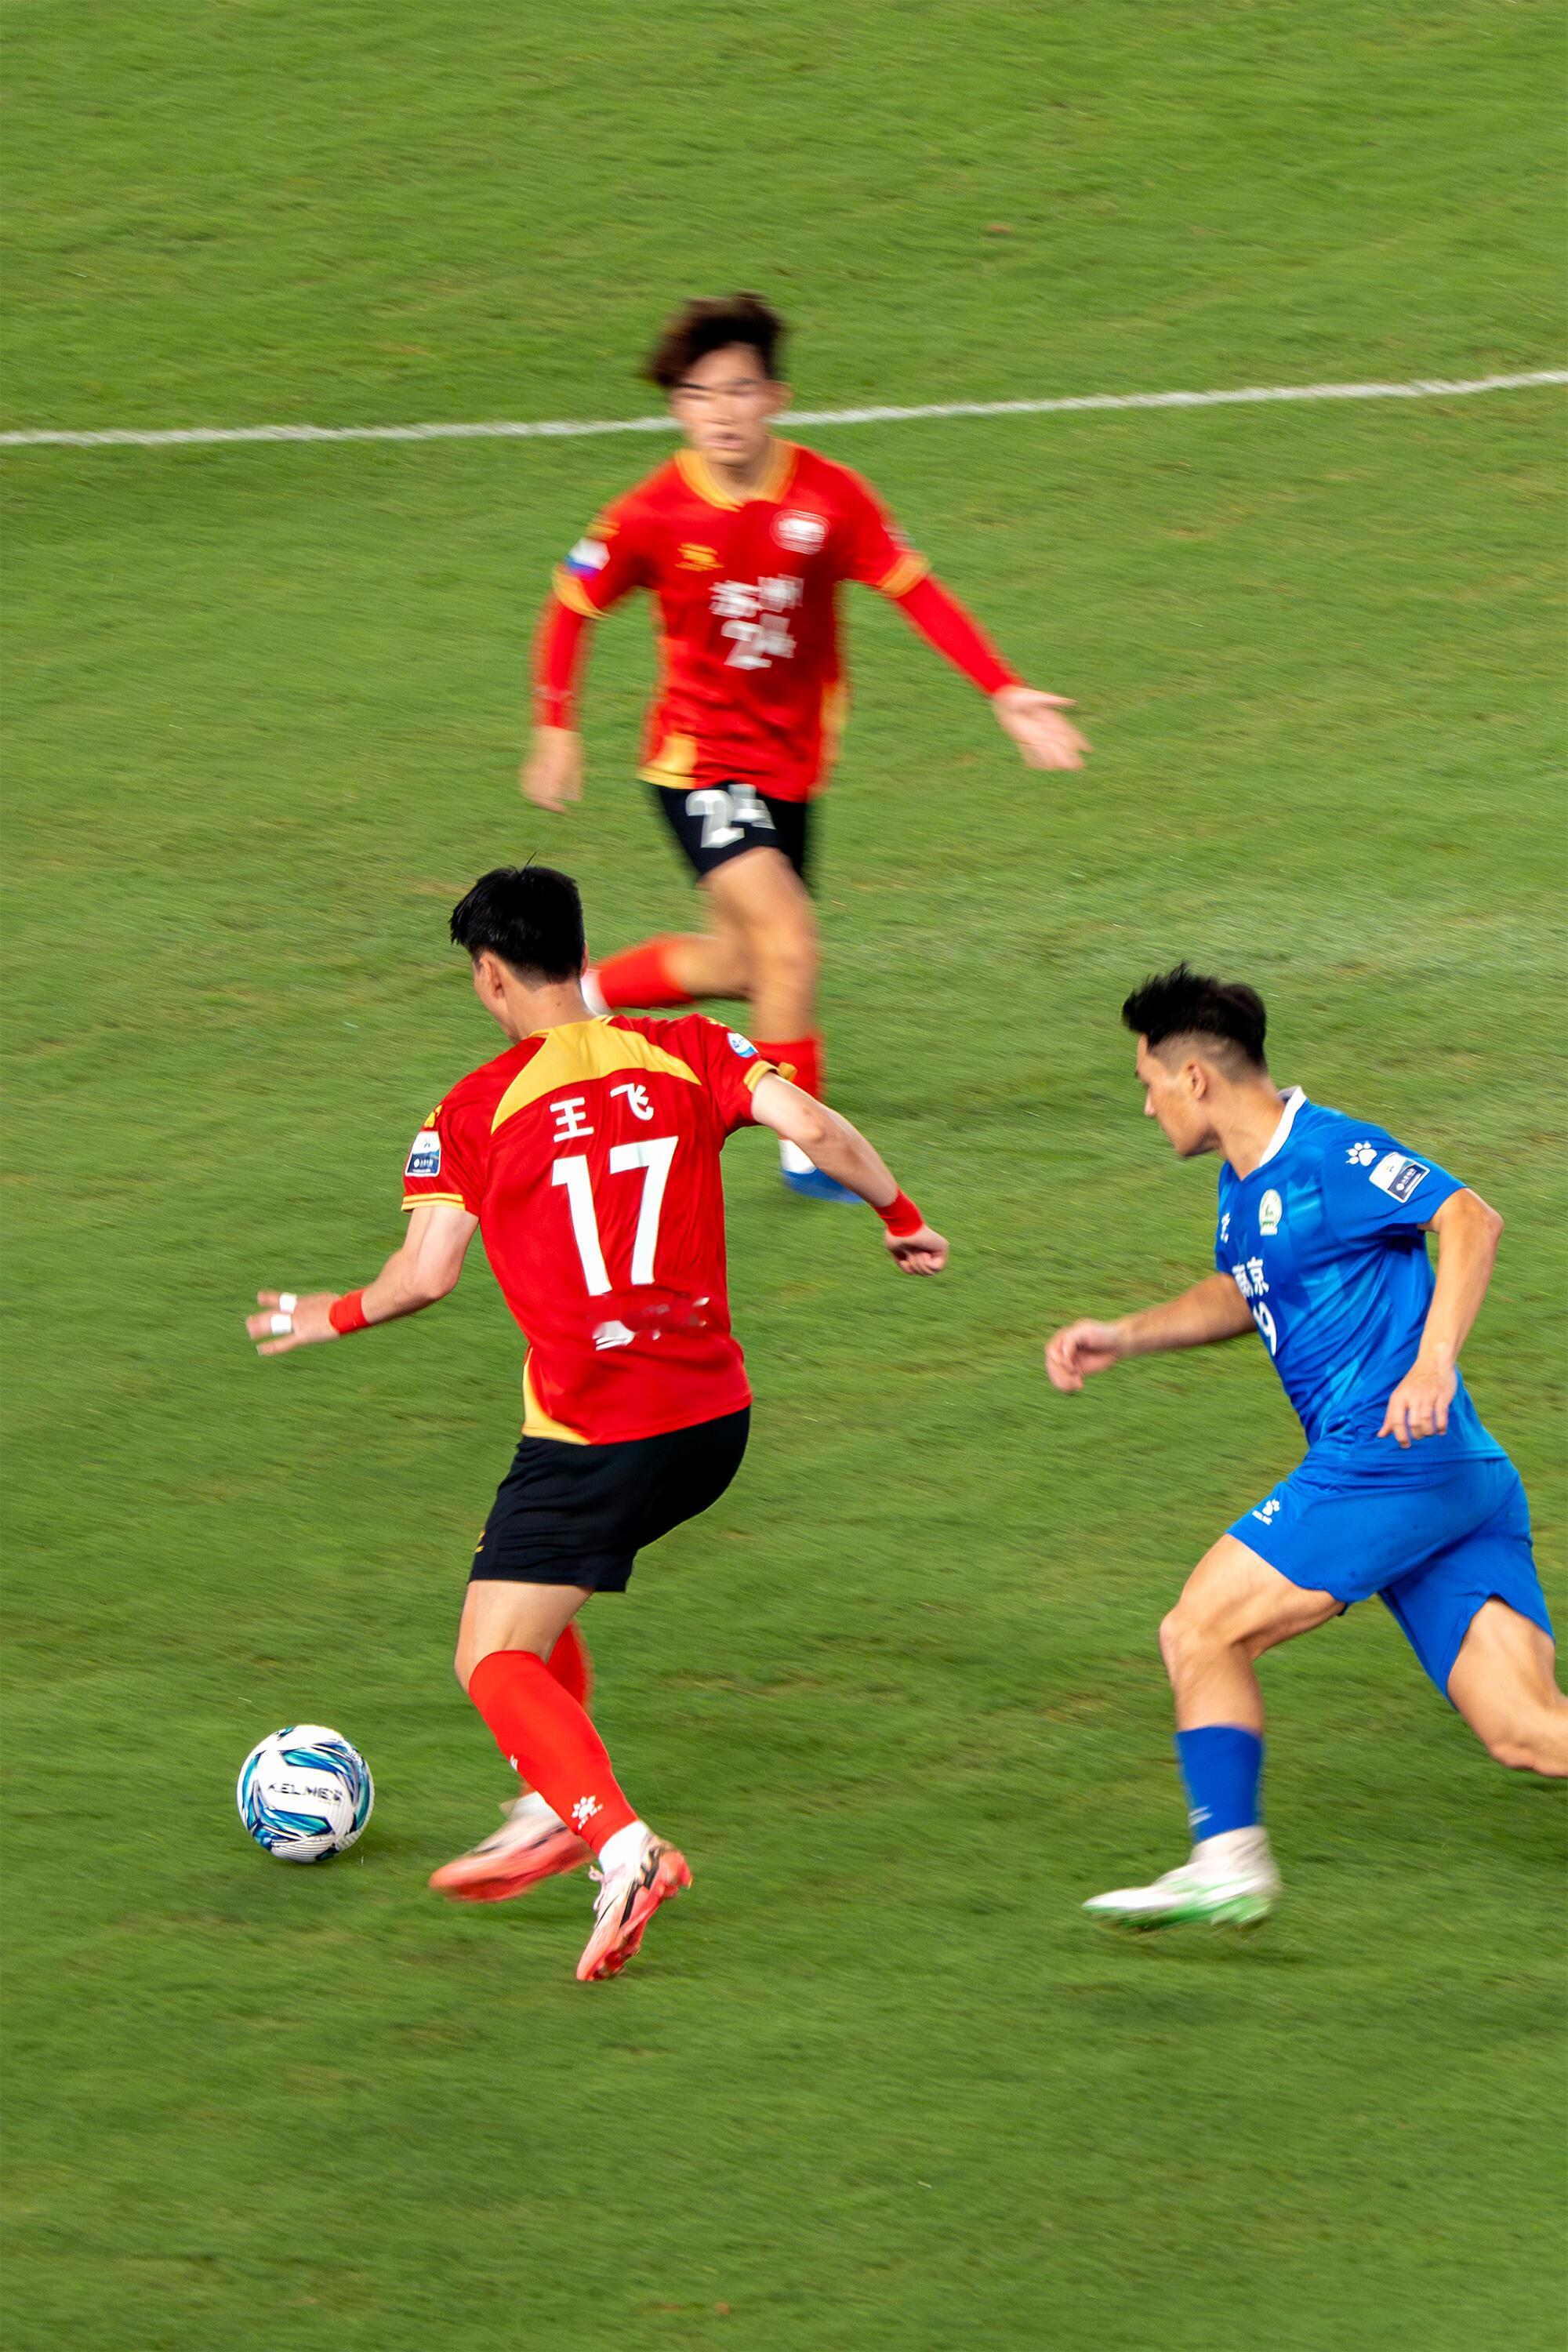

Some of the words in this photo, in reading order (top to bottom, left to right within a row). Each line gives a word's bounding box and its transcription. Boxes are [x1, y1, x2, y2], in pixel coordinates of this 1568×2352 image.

[720, 613, 797, 670] 24
[685, 783, 777, 848] 24
[550, 1083, 654, 1142] 王飞
[551, 1136, 679, 1296] 17
